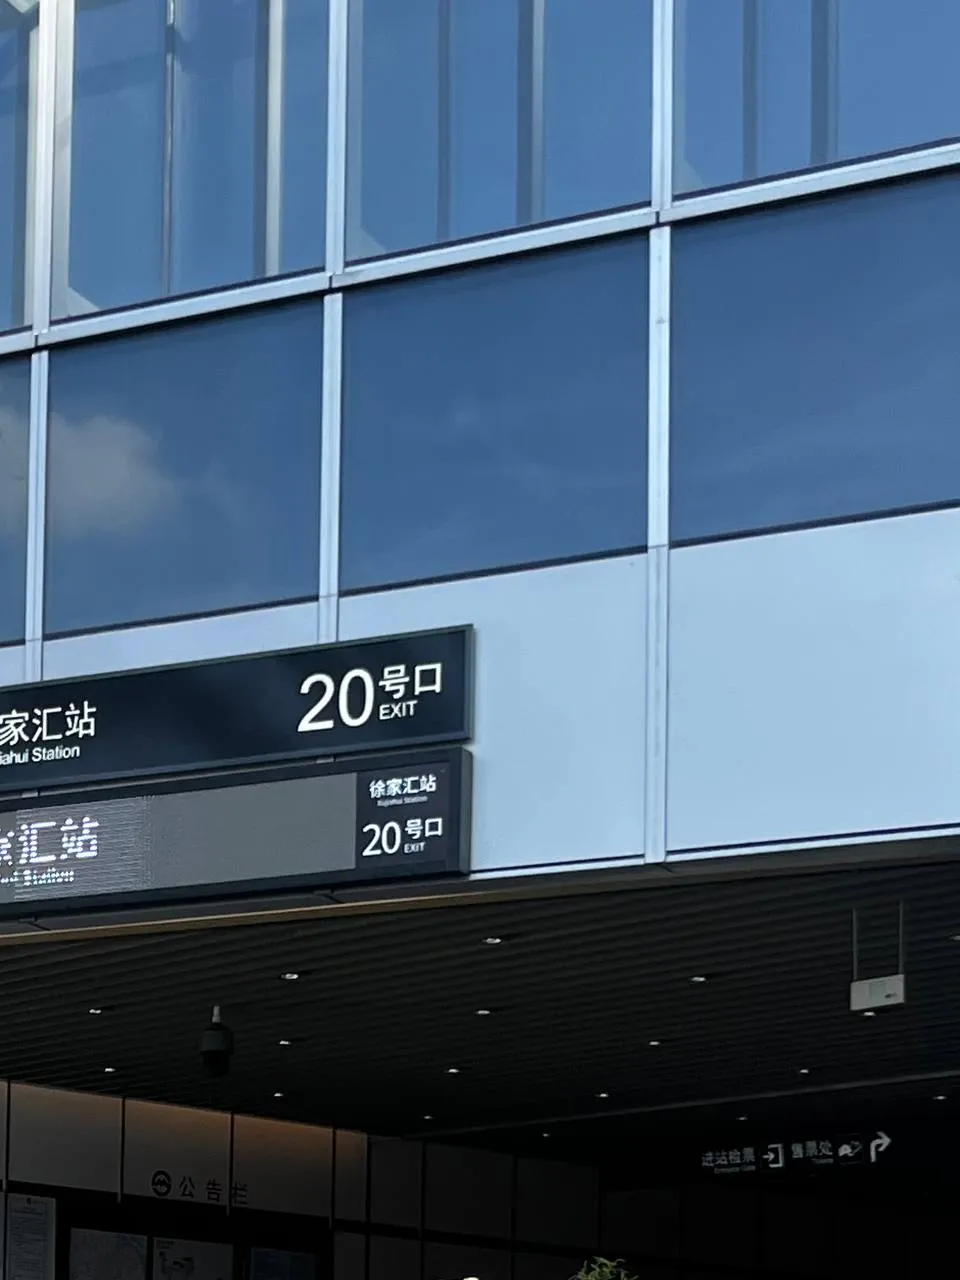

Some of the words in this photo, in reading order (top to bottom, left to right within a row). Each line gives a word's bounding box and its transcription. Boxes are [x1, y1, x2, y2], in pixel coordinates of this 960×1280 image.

[297, 668, 374, 732] 20
[378, 662, 442, 699] 号口
[378, 700, 418, 720] EXIT
[32, 745, 80, 763] Station
[369, 774, 436, 799] 徐家汇站
[362, 821, 401, 856] 20
[405, 817, 442, 839] 号口
[404, 842, 426, 853] EXIT
[179, 1176, 248, 1205] 公告栏
